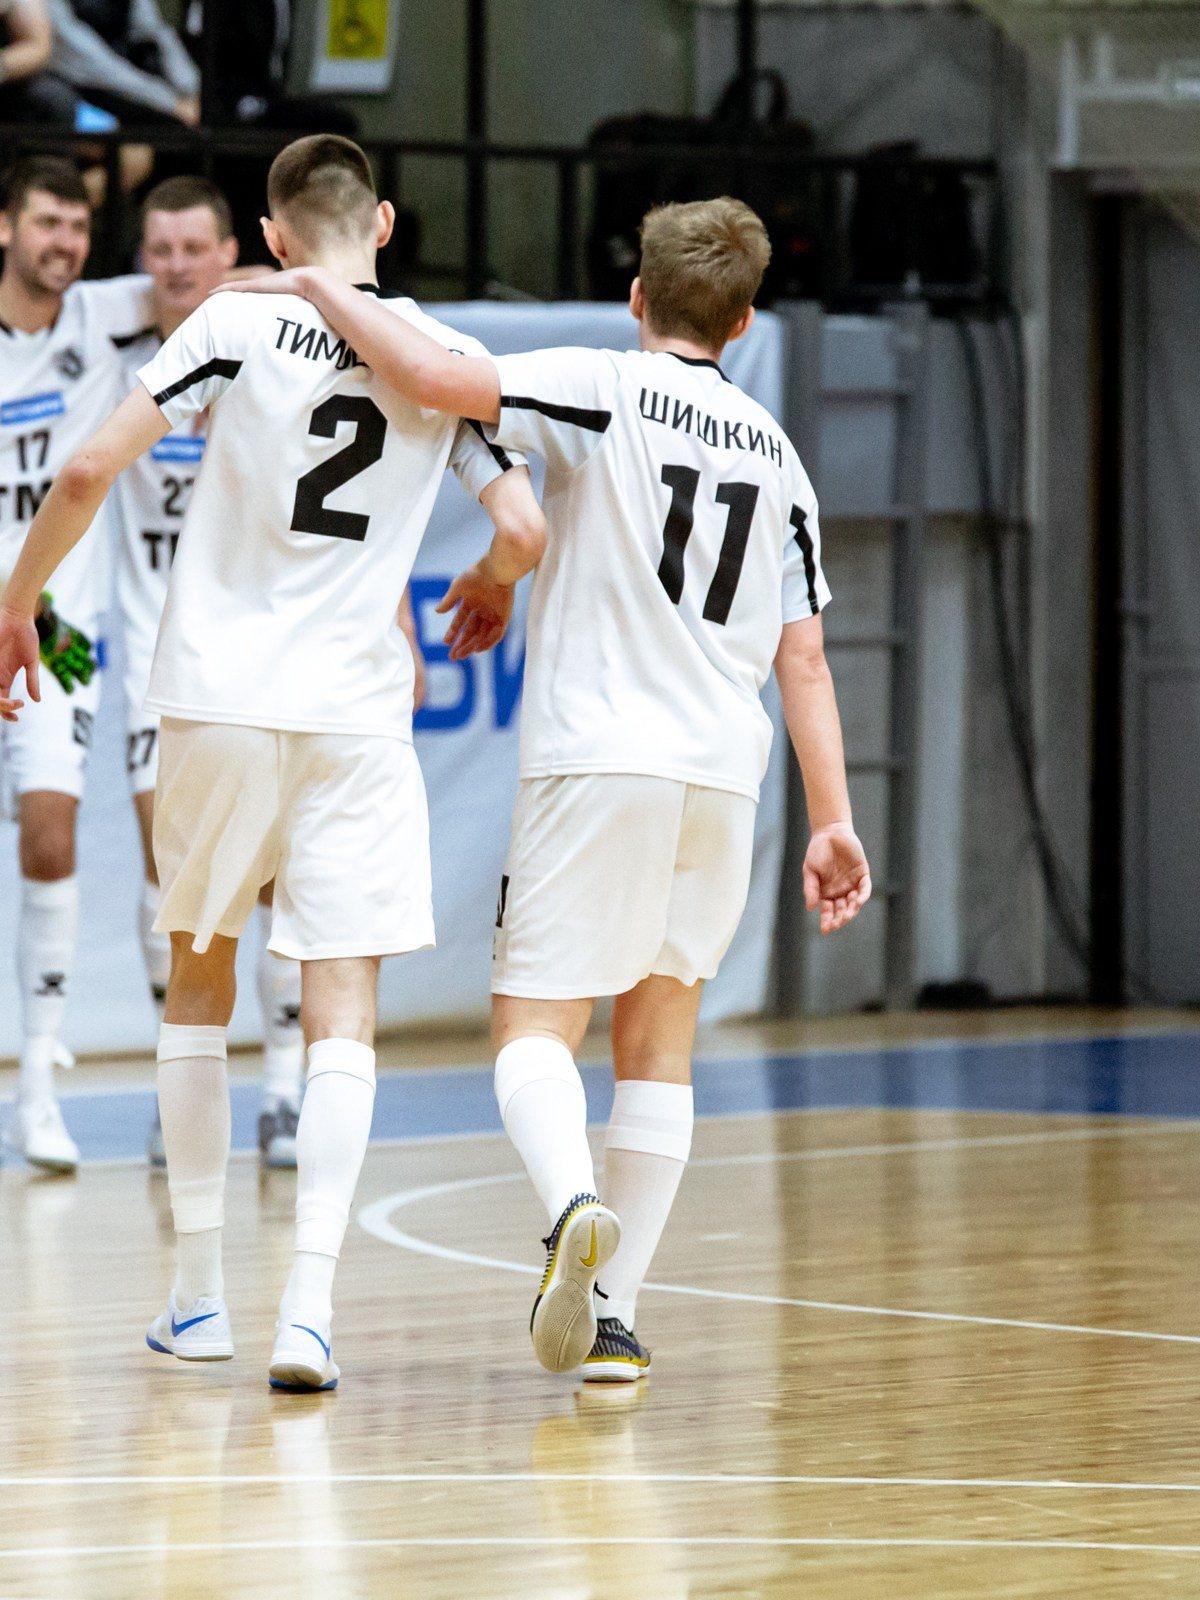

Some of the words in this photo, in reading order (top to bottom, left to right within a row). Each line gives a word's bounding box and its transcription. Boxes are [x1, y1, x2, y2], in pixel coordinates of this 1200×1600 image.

[17, 428, 50, 472] 17
[290, 394, 387, 541] 2
[639, 388, 782, 468] ШИШКИН
[658, 464, 760, 626] 11
